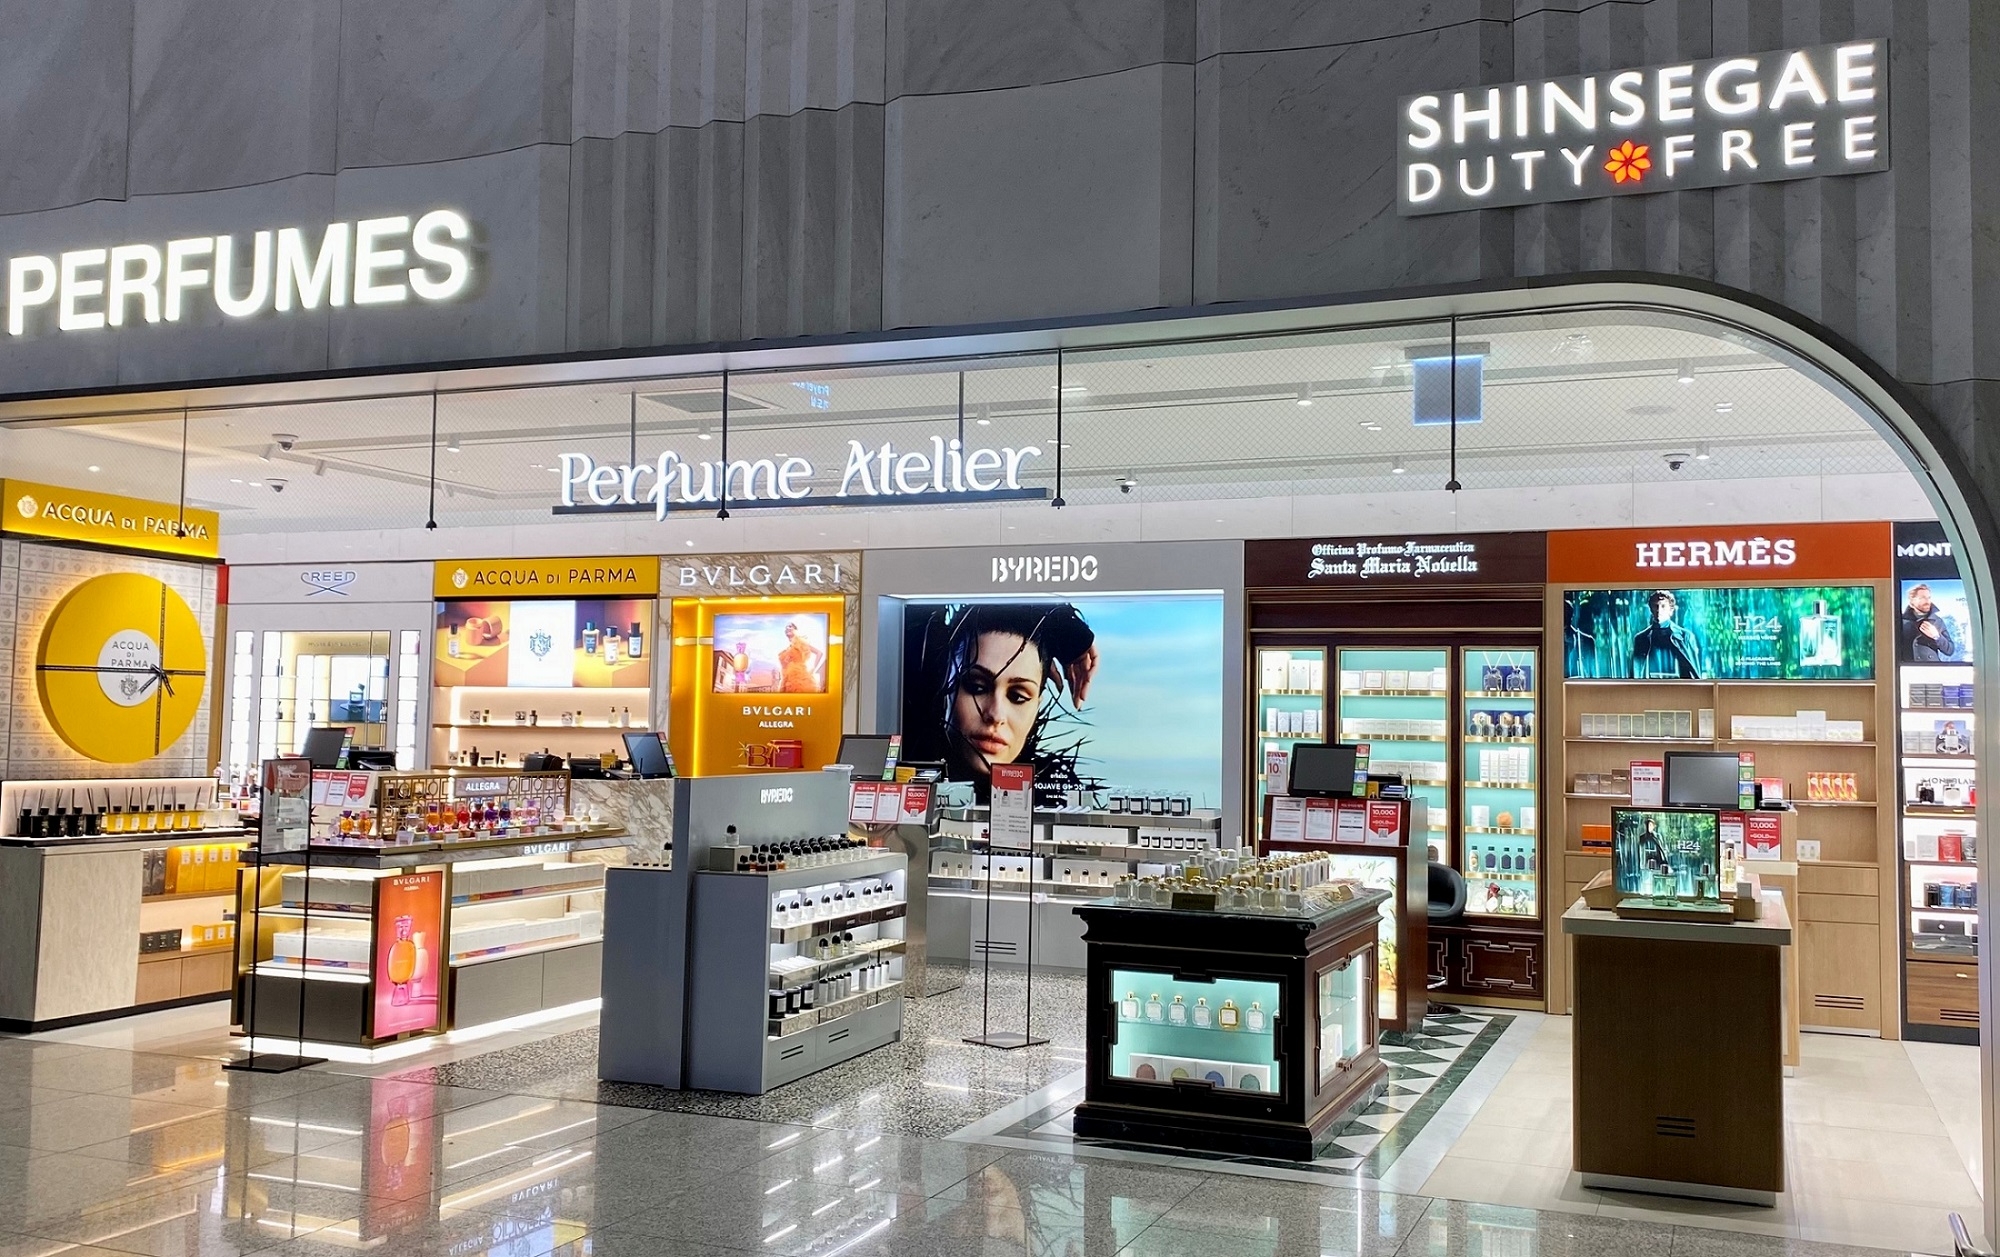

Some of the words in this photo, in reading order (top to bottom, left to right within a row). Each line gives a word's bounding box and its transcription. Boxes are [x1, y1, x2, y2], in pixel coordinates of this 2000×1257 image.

[1407, 42, 1877, 149] SHINSEGAE
[1407, 144, 1595, 203] DUTY
[1665, 115, 1877, 177] FREE
[8, 209, 471, 336] PERFUMES
[557, 450, 814, 522] Perfume
[837, 435, 1043, 496] Atelier
[42, 502, 116, 528] ACQUA
[121, 516, 136, 531] DI
[143, 516, 209, 540] PARMA
[1311, 544, 1355, 557] Officina
[1356, 541, 1475, 558] Profumo-Farmaceutica
[1635, 536, 1797, 568] HERMÈS
[1896, 542, 1952, 557] MONT
[679, 563, 842, 587] BVLGARI
[991, 555, 1098, 583] BYREDO
[1307, 557, 1357, 579] Santa
[1360, 556, 1411, 579] Maria
[1414, 555, 1478, 578] Novella
[473, 568, 540, 586] ACQUA
[546, 573, 561, 584] DI
[568, 567, 638, 584] PARMA
[1733, 615, 1783, 633] H24
[112, 641, 150, 651] ACQUA
[111, 658, 149, 668] PARMA
[742, 706, 811, 716] BVLGARI
[758, 720, 794, 729] ALLEGRA
[465, 780, 501, 792] ALLEGRA
[760, 787, 794, 804] BYREDO
[523, 841, 571, 856] BVLGARI
[1677, 840, 1701, 850] H24
[393, 875, 430, 886] BVLGARI
